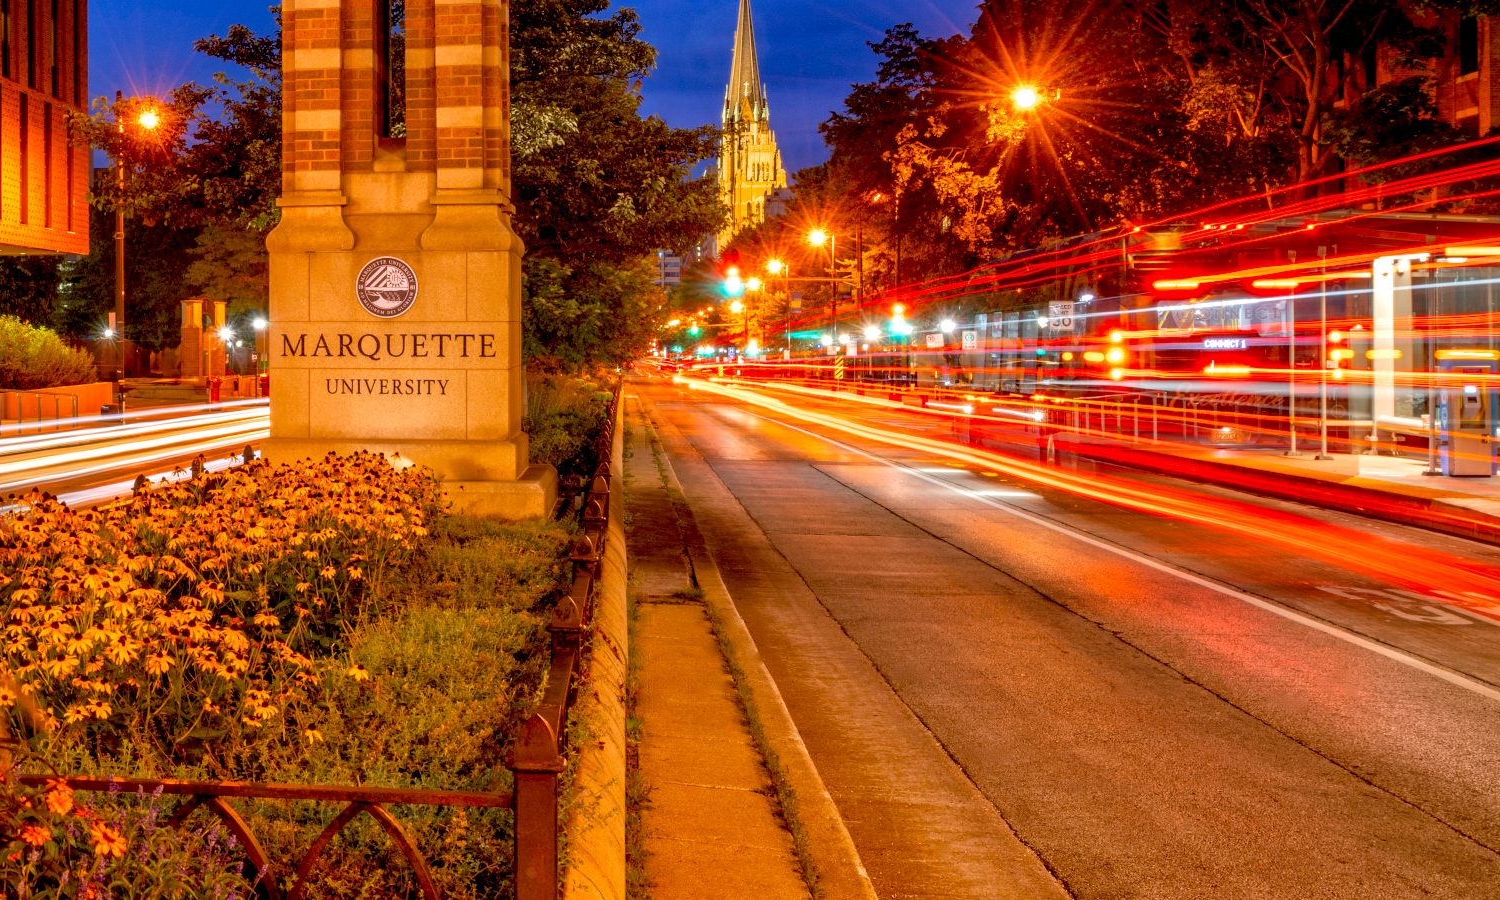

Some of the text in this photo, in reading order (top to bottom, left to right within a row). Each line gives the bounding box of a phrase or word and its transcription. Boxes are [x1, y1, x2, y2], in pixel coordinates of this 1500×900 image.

[360, 259, 415, 283] MARQUETTE UNIVERSITY
[1052, 316, 1072, 327] 30
[281, 333, 497, 360] MARQUETTE
[1204, 339, 1239, 348] CONNECT
[326, 378, 450, 395] UNIVERSITY
[1169, 381, 1286, 408] Excellence
